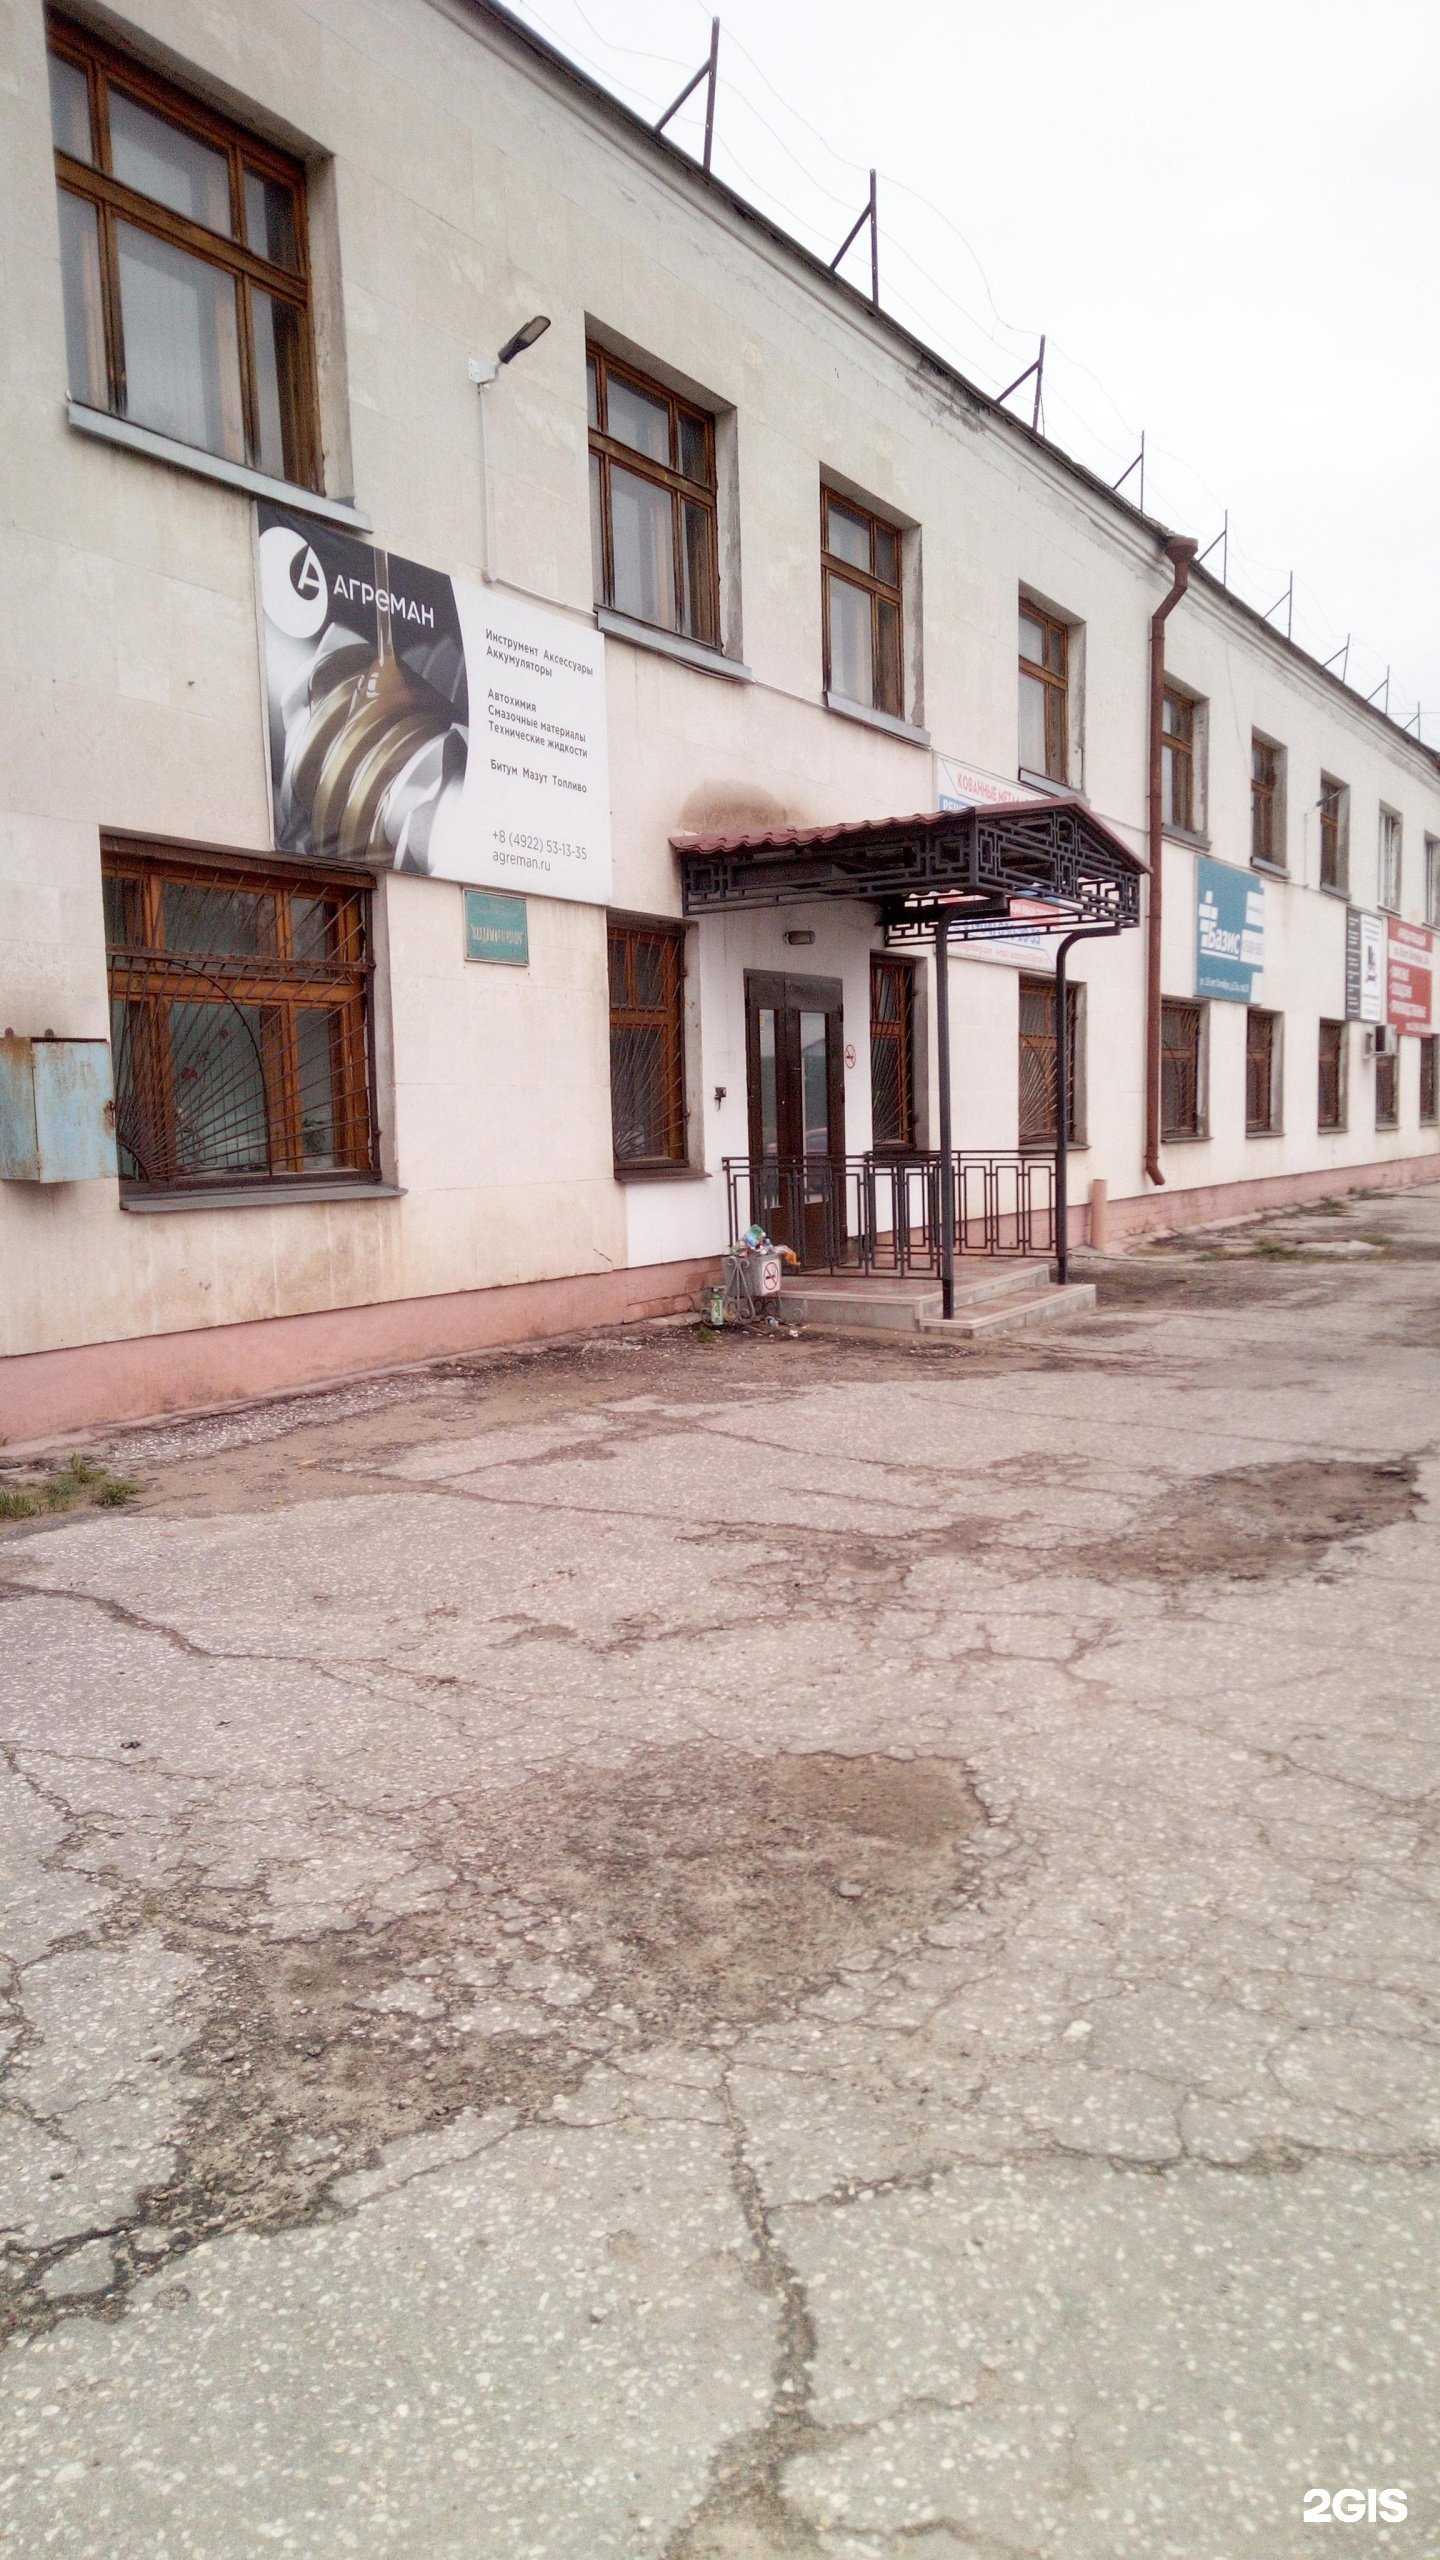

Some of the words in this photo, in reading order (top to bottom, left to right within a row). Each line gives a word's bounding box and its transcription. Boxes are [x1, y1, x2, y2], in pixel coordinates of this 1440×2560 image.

[486, 628, 538, 656] Инструмент
[543, 649, 593, 675] Аксессуары
[486, 645, 552, 677] Аккумуляторы
[488, 687, 536, 712] Автохимия
[488, 704, 538, 728] Смазочные
[540, 722, 586, 743] материалы
[488, 720, 545, 746] Технические
[547, 738, 588, 758] жидкости
[490, 759, 518, 776] Битум
[522, 767, 548, 784] Мазут
[552, 775, 588, 793] Топливо
[492, 829, 506, 844] +8
[508, 831, 544, 854] (4922)
[546, 839, 588, 861] 53-13-35
[492, 850, 551, 872] agreman.ru
